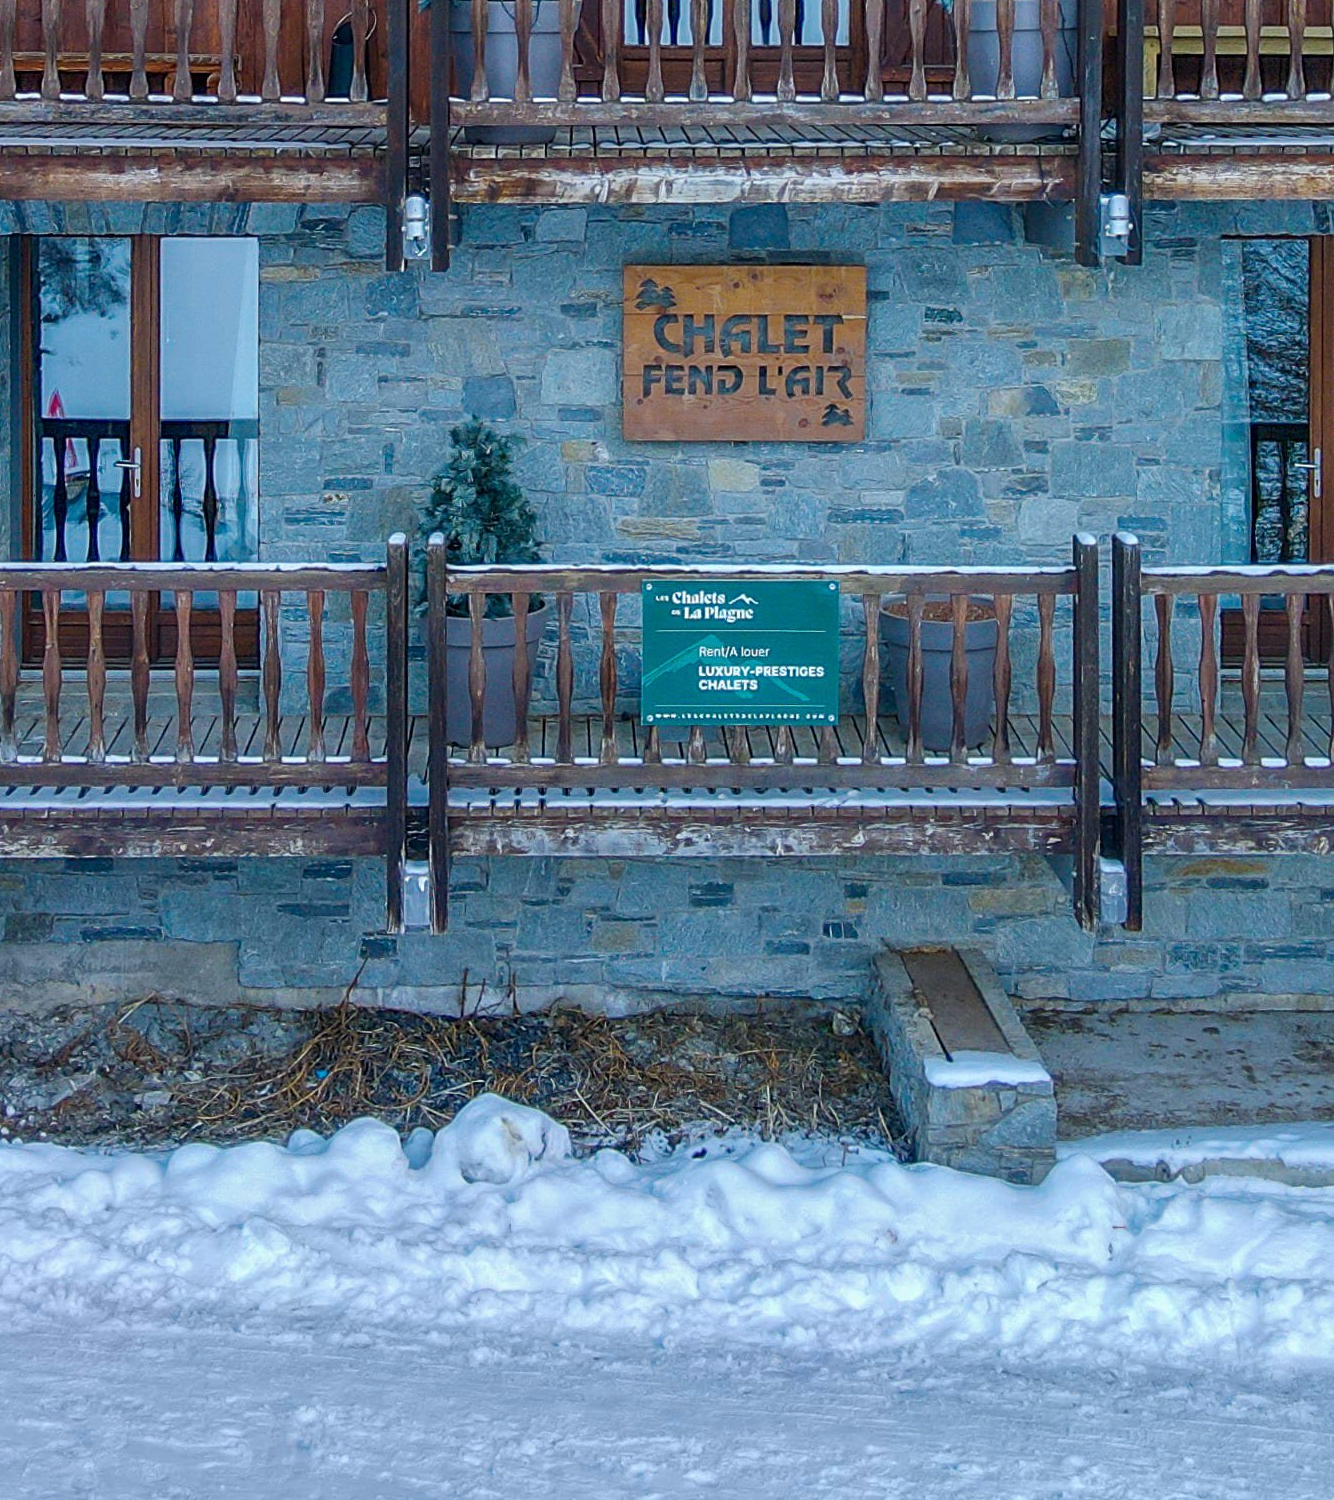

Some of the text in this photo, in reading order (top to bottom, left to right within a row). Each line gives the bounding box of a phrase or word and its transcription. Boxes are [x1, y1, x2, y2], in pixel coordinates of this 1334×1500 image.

[653, 314, 844, 358] CHALET
[642, 364, 853, 399] FEND L'AIR
[672, 590, 726, 605] Chalets
[684, 606, 702, 619] La
[704, 605, 754, 623] Plagne
[699, 646, 770, 658] Rent/A louer
[698, 666, 825, 677] LUXURY-PRESTIGES
[698, 679, 759, 691] CHALETS
